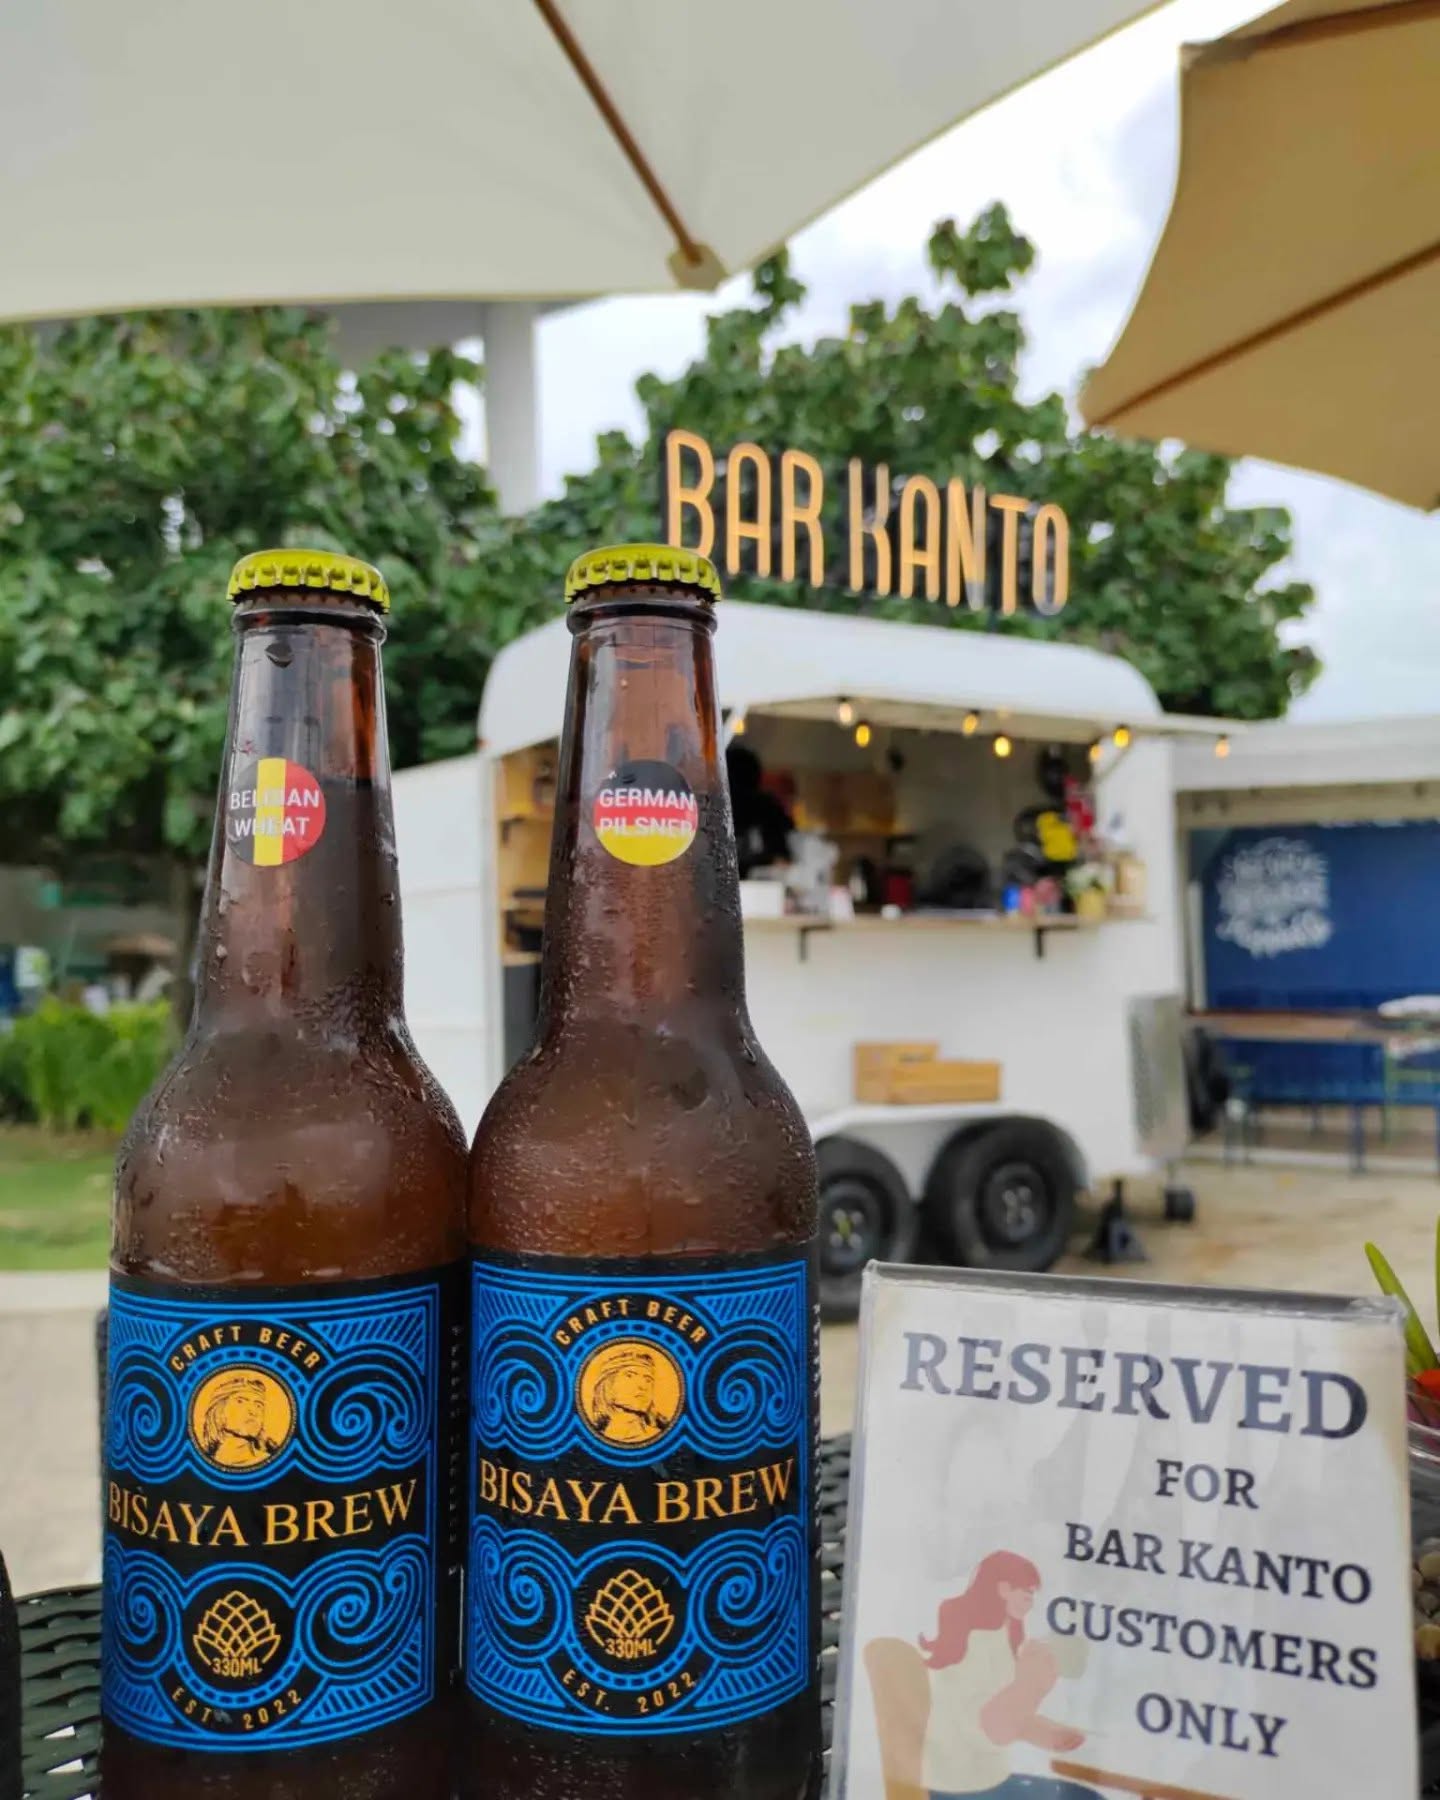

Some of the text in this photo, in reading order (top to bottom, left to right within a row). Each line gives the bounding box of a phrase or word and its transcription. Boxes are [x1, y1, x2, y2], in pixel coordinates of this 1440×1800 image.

[666, 429, 1069, 616] BAR KANTO
[600, 787, 695, 811] GERMAN
[555, 1299, 707, 1346] CRAFT BEER
[170, 1325, 323, 1372] CRAFT BEER
[900, 1331, 1369, 1439] RESERVED
[479, 1457, 796, 1525] BISAYA BREW
[1155, 1459, 1259, 1509] FOR
[108, 1479, 417, 1547] BISAYA BREW
[1063, 1522, 1372, 1604] BAR KANTO
[211, 1656, 263, 1678] 330ML
[604, 1637, 657, 1660] 330ML
[1046, 1596, 1378, 1690] CUSTOMERS
[242, 1689, 302, 1730] 2022
[637, 1671, 696, 1713] 2022
[1136, 1692, 1288, 1757] ONLY
